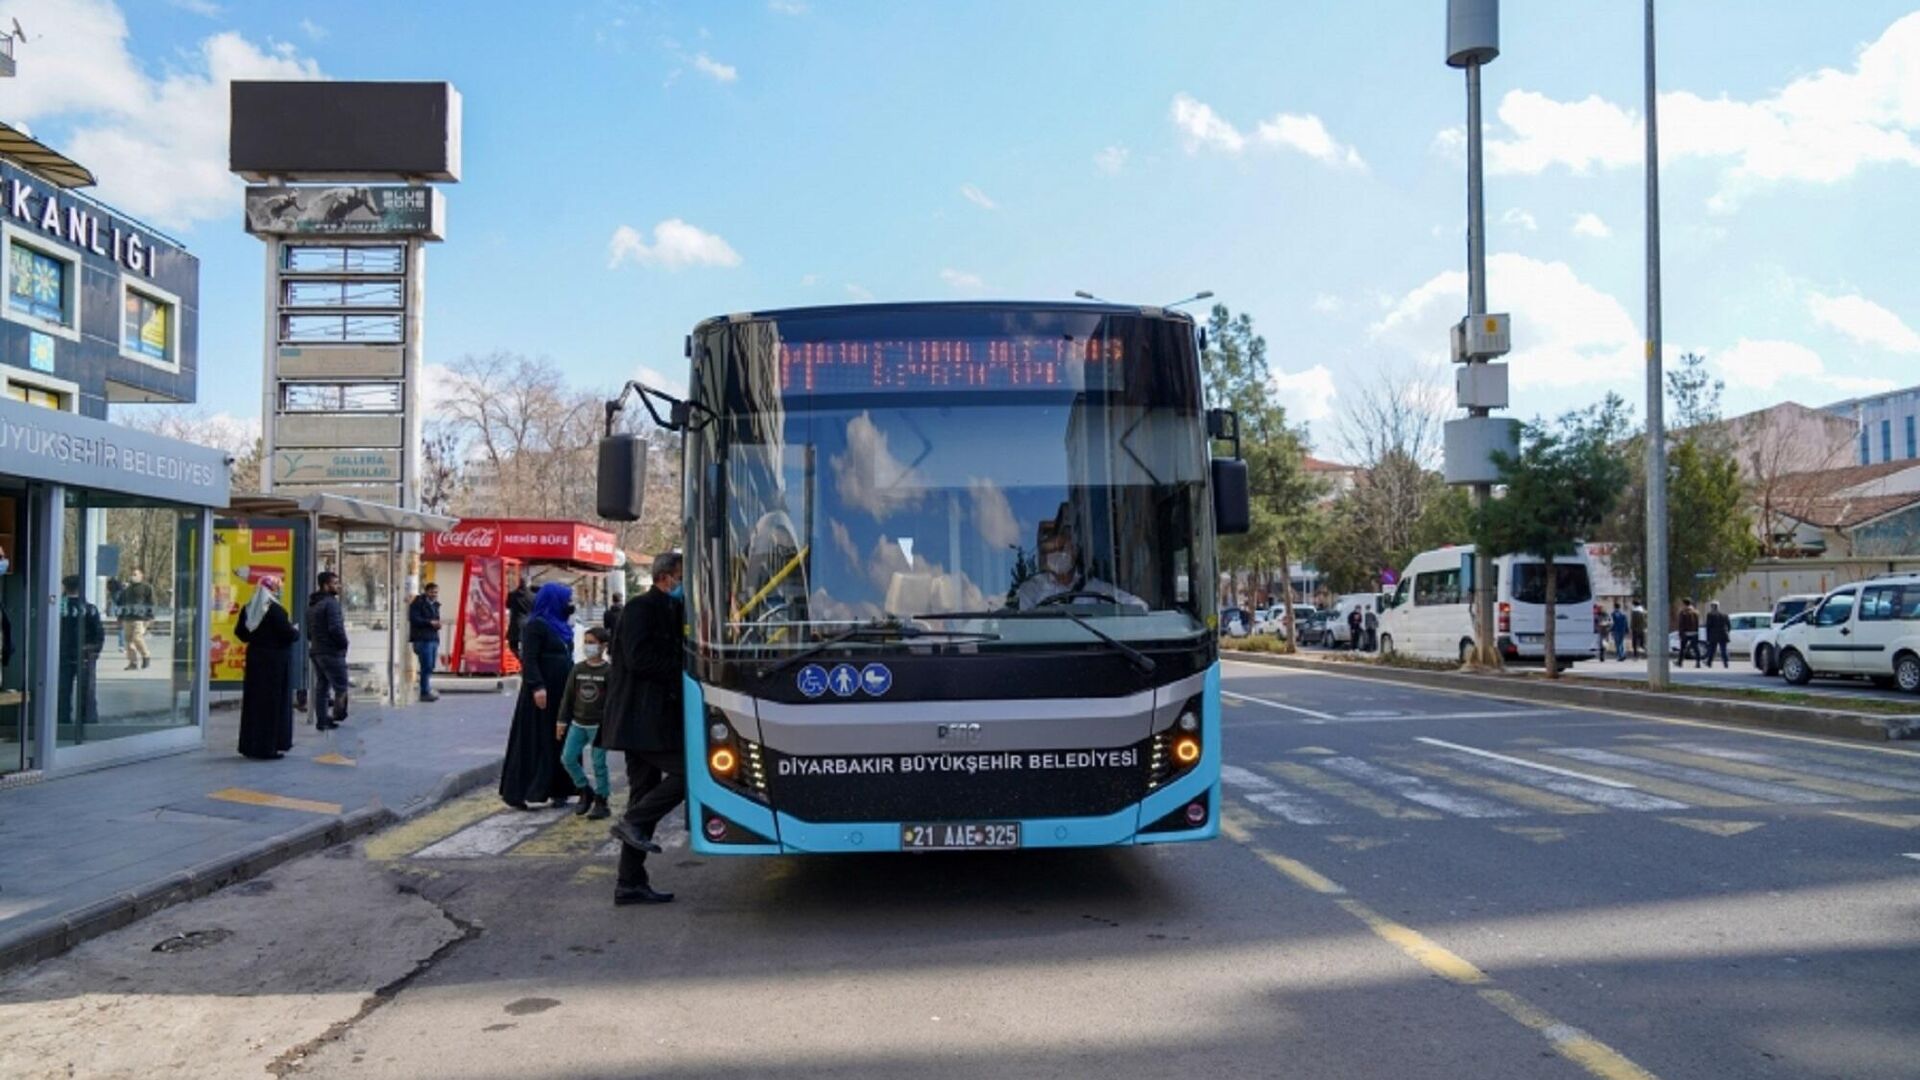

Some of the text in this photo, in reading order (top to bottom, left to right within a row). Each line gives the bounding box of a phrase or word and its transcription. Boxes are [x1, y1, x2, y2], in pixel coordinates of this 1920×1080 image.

[0, 177, 155, 278] KANLIĞI
[779, 749, 1138, 775] DİYARBAKIR BÜYÜKŞEHİR BELEDİYESİ
[914, 825, 1017, 846] 21 AAE 325
